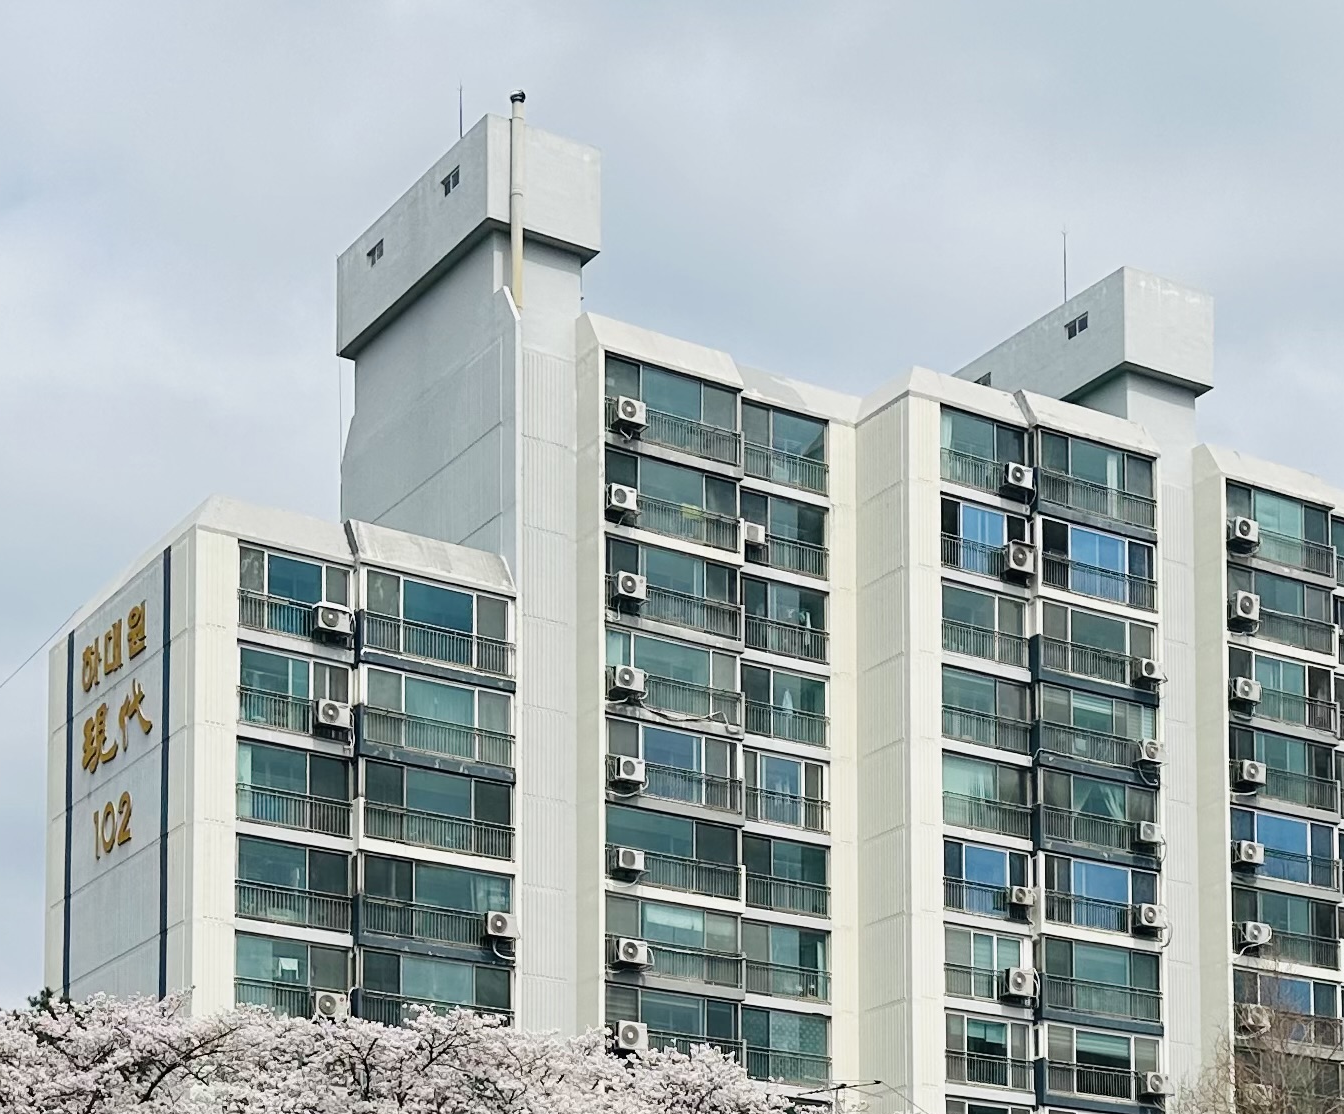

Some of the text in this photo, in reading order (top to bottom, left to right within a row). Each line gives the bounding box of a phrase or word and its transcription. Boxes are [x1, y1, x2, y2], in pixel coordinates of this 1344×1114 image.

[81, 600, 147, 693] 하대원
[81, 678, 154, 774] 現代
[93, 791, 133, 861] 102
